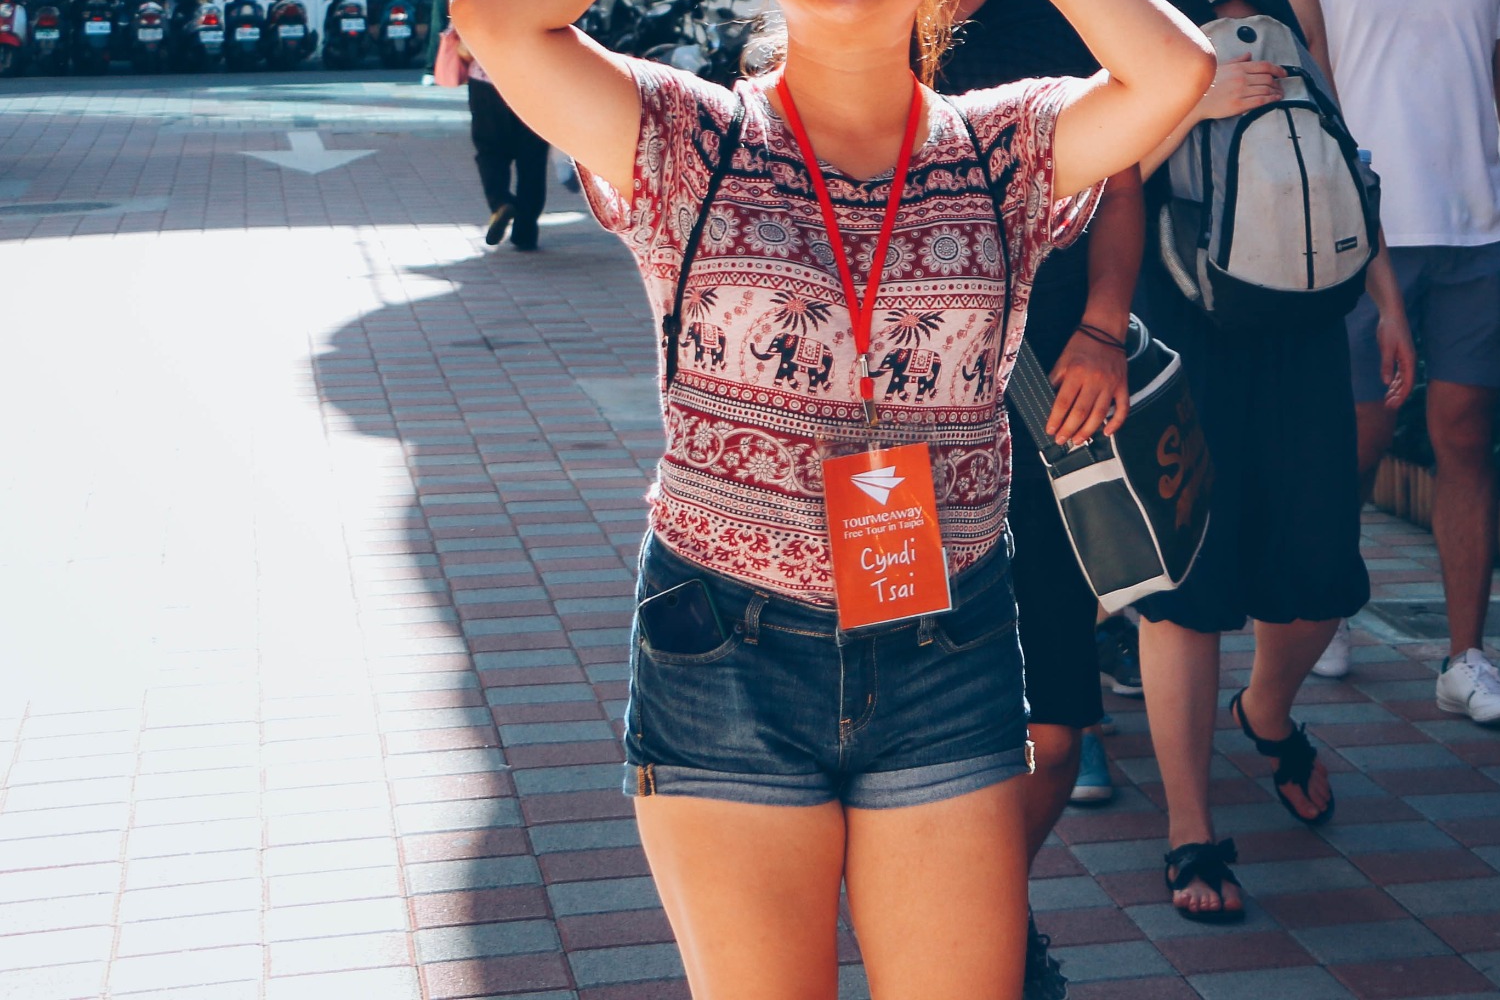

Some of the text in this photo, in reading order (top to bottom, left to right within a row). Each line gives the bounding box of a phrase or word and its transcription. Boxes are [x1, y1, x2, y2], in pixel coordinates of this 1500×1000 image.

[844, 517, 924, 540] Free Tour in Taipei
[860, 537, 916, 574] Cyndi
[870, 572, 915, 603] Tsai
